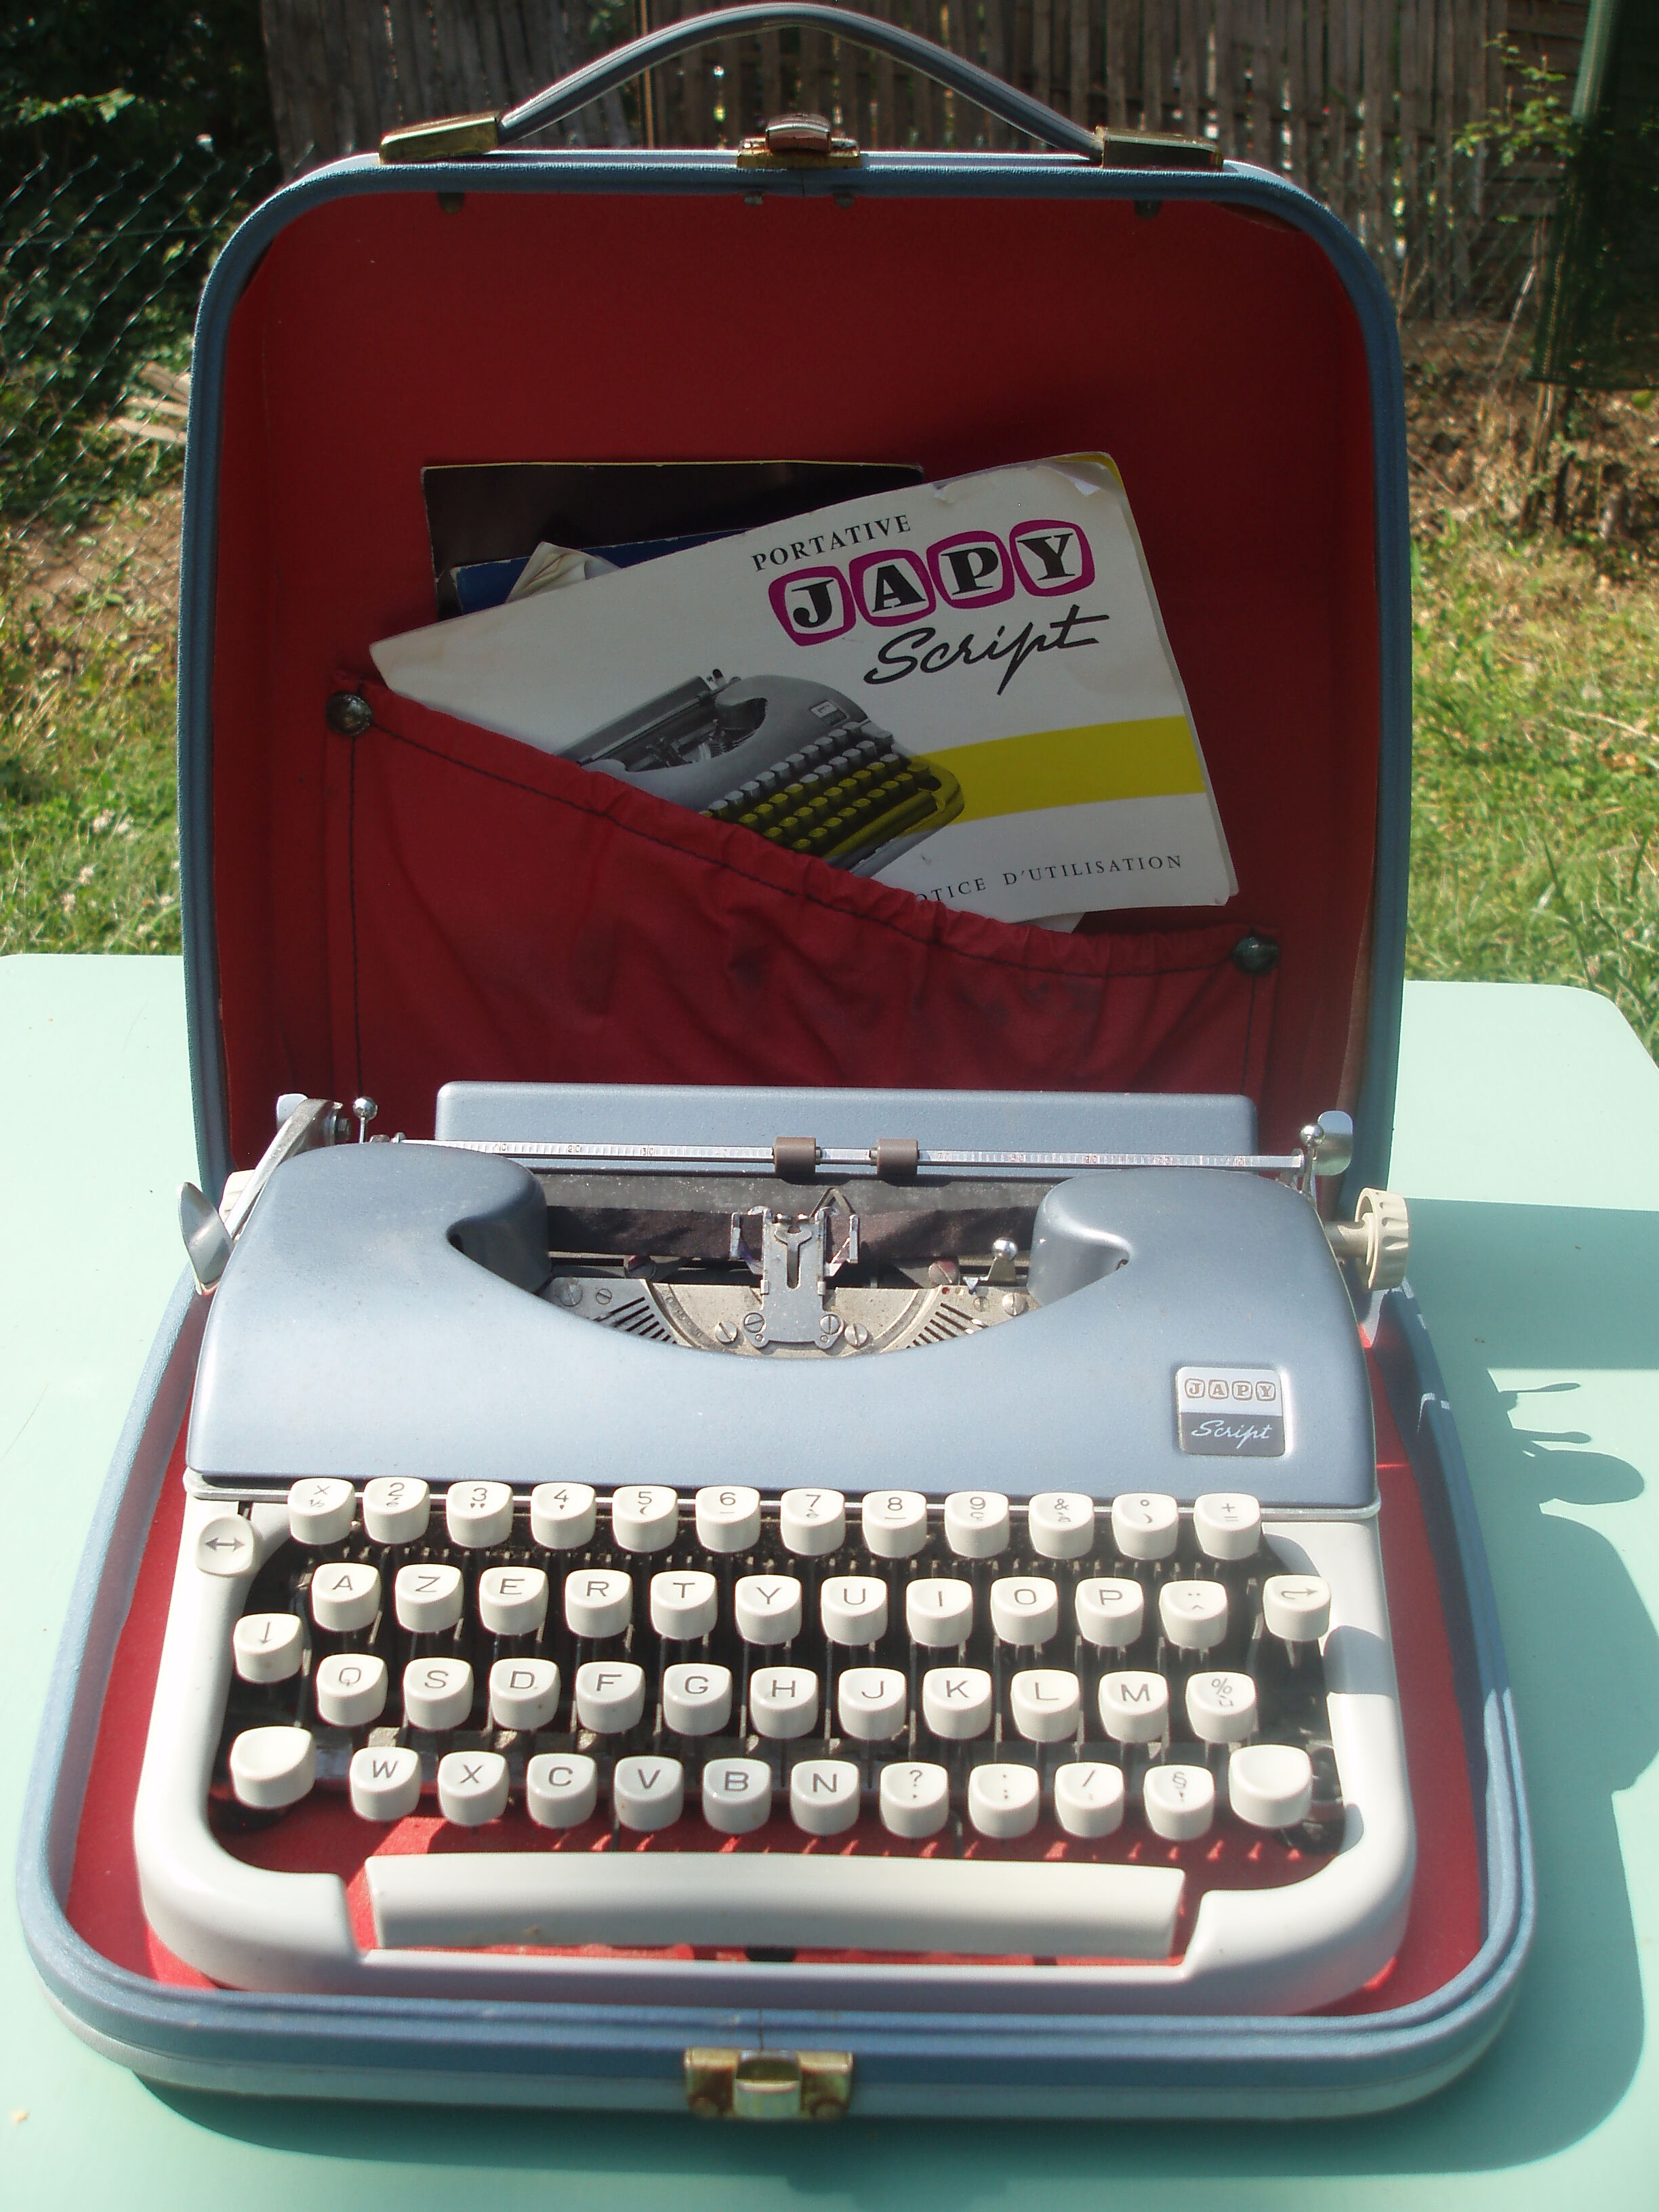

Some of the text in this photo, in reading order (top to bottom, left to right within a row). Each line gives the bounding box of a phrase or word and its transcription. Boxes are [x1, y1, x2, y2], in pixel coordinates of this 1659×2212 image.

[752, 514, 912, 572] PORTATIVE
[790, 533, 1076, 629] JAPY
[863, 604, 1110, 695] Script
[916, 855, 1182, 901] TICE D'UTILISATION
[1189, 1382, 1271, 1397] JAPY
[1191, 1419, 1272, 1449] Script
[388, 1483, 405, 1496] 2
[472, 1488, 487, 1501] 3
[554, 1490, 569, 1502] 4
[638, 1492, 652, 1504] 5
[720, 1492, 735, 1505] 6
[806, 1494, 821, 1507] 7
[888, 1497, 903, 1511] 8
[970, 1497, 986, 1510] 9
[1054, 1498, 1069, 1510] &
[332, 1576, 352, 1591] A
[415, 1576, 440, 1592] Z
[499, 1578, 525, 1595] E
[587, 1581, 609, 1597] R
[673, 1582, 695, 1598] T
[756, 1587, 781, 1605] Y
[844, 1589, 865, 1605] U
[1014, 1589, 1036, 1605] O
[1099, 1589, 1122, 1605] P
[339, 1667, 361, 1686] Q
[424, 1670, 449, 1688] S
[510, 1671, 535, 1689] D
[596, 1674, 621, 1692] F
[684, 1676, 708, 1694] G
[772, 1679, 796, 1697] H
[861, 1681, 884, 1698] J
[946, 1681, 968, 1698] K
[1035, 1682, 1059, 1700] L
[1121, 1684, 1150, 1702] M
[1211, 1678, 1232, 1696] %
[373, 1760, 398, 1778] W
[460, 1765, 483, 1783] X
[548, 1767, 573, 1786] C
[909, 1769, 922, 1786] ?
[638, 1769, 661, 1789] V
[724, 1771, 749, 1792] B
[813, 1773, 837, 1793] N
